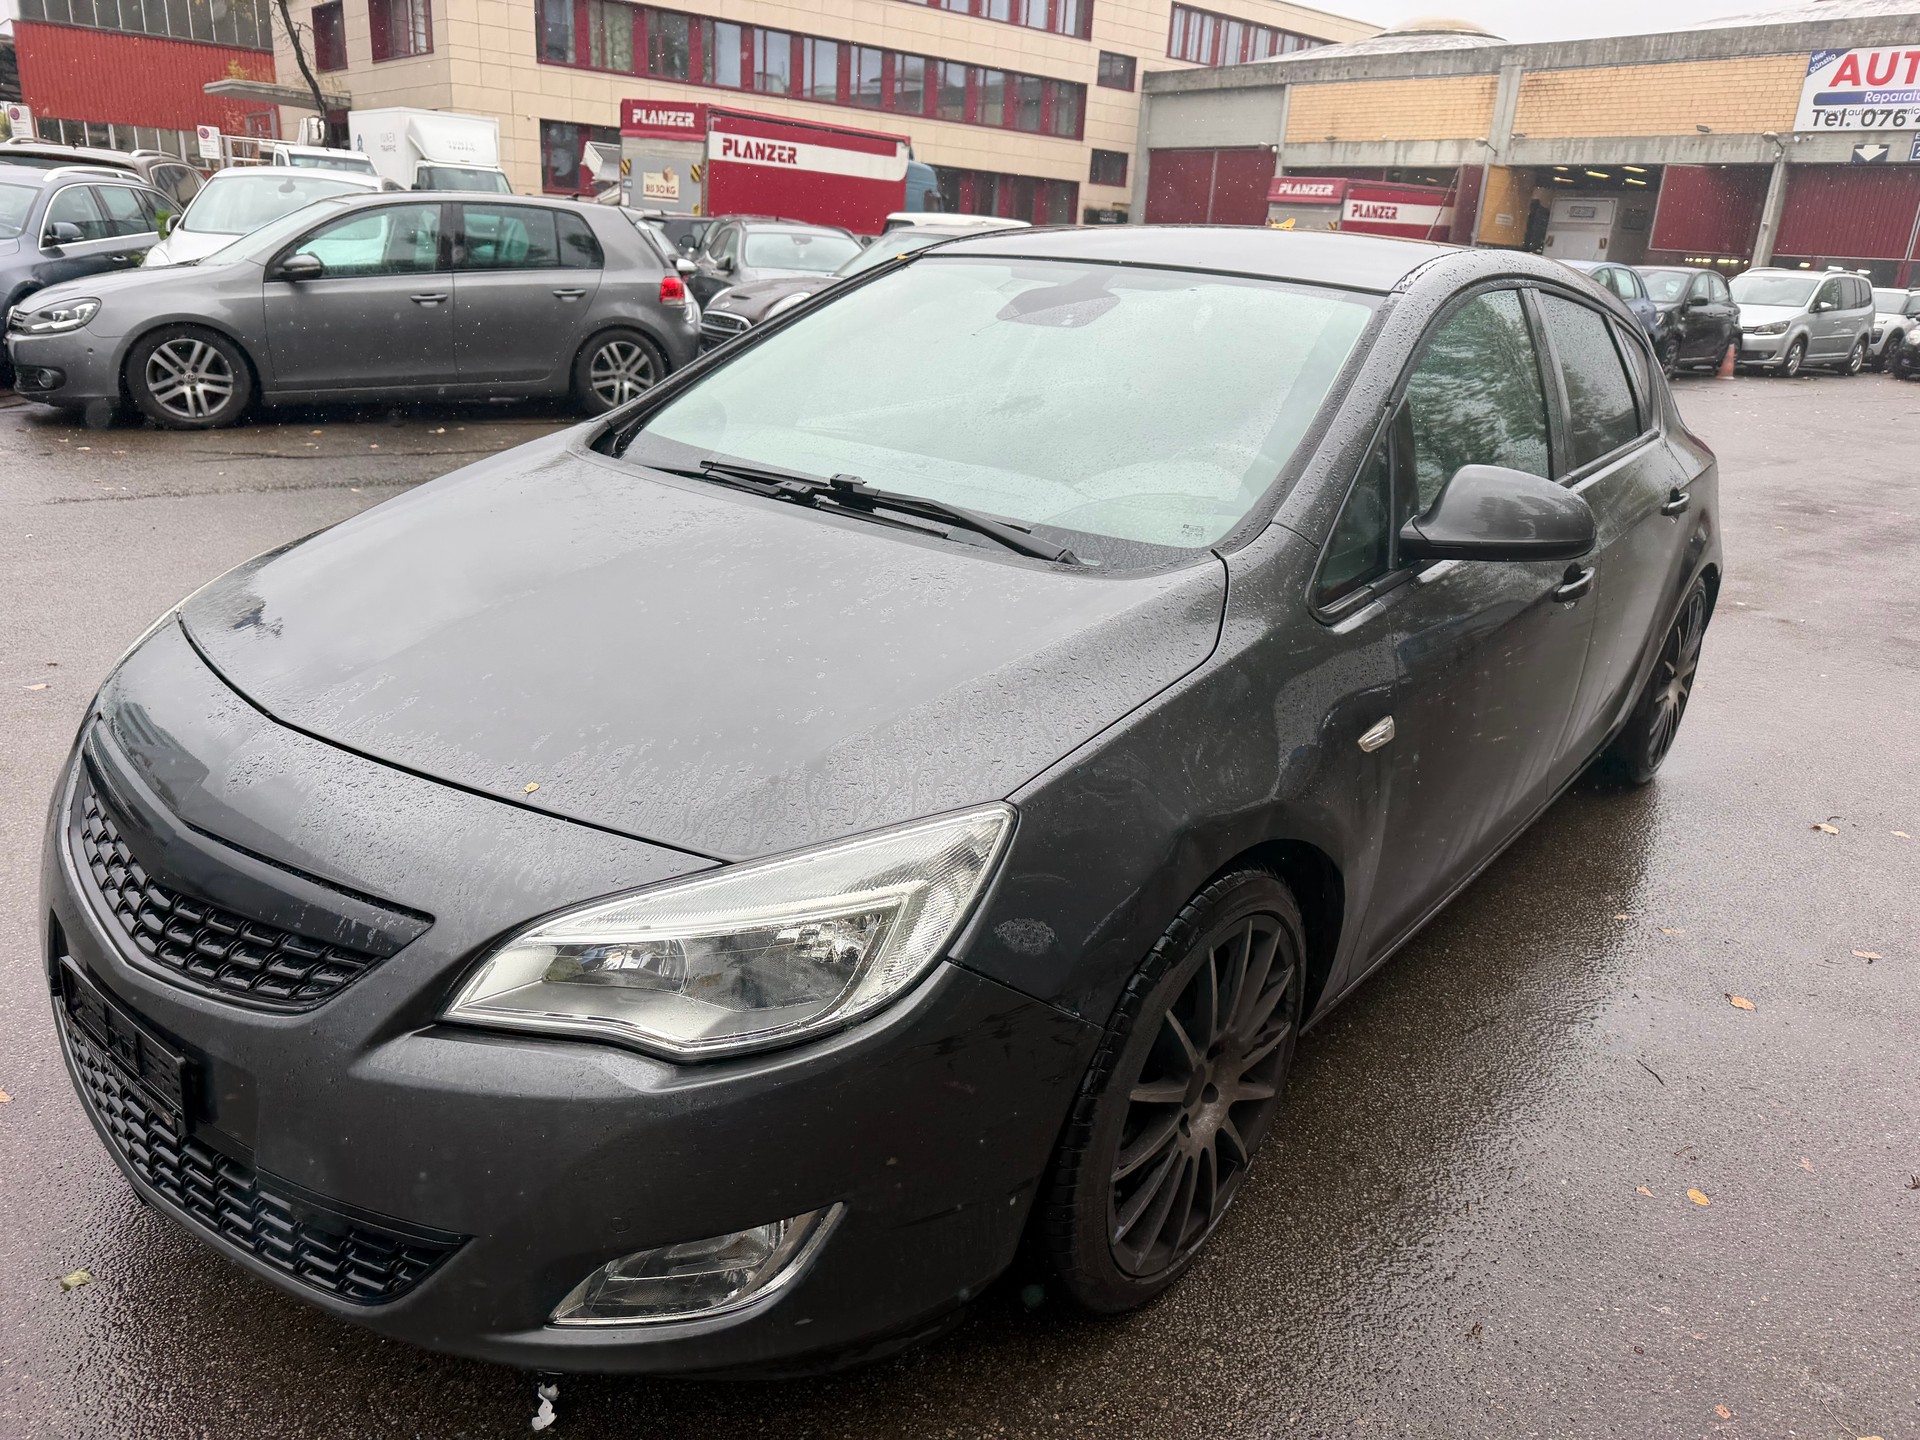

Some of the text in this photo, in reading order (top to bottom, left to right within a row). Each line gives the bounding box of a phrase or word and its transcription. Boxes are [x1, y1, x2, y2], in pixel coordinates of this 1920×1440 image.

[1809, 53, 1837, 73] günstig
[1812, 50, 1826, 63] Hier
[632, 108, 695, 128] PLANZER
[1812, 108, 1851, 127] Tel.
[1860, 108, 1907, 128] 076
[722, 137, 798, 165] PLANZER
[1278, 183, 1335, 196] PLANZER
[1351, 203, 1398, 220] PLANZER
